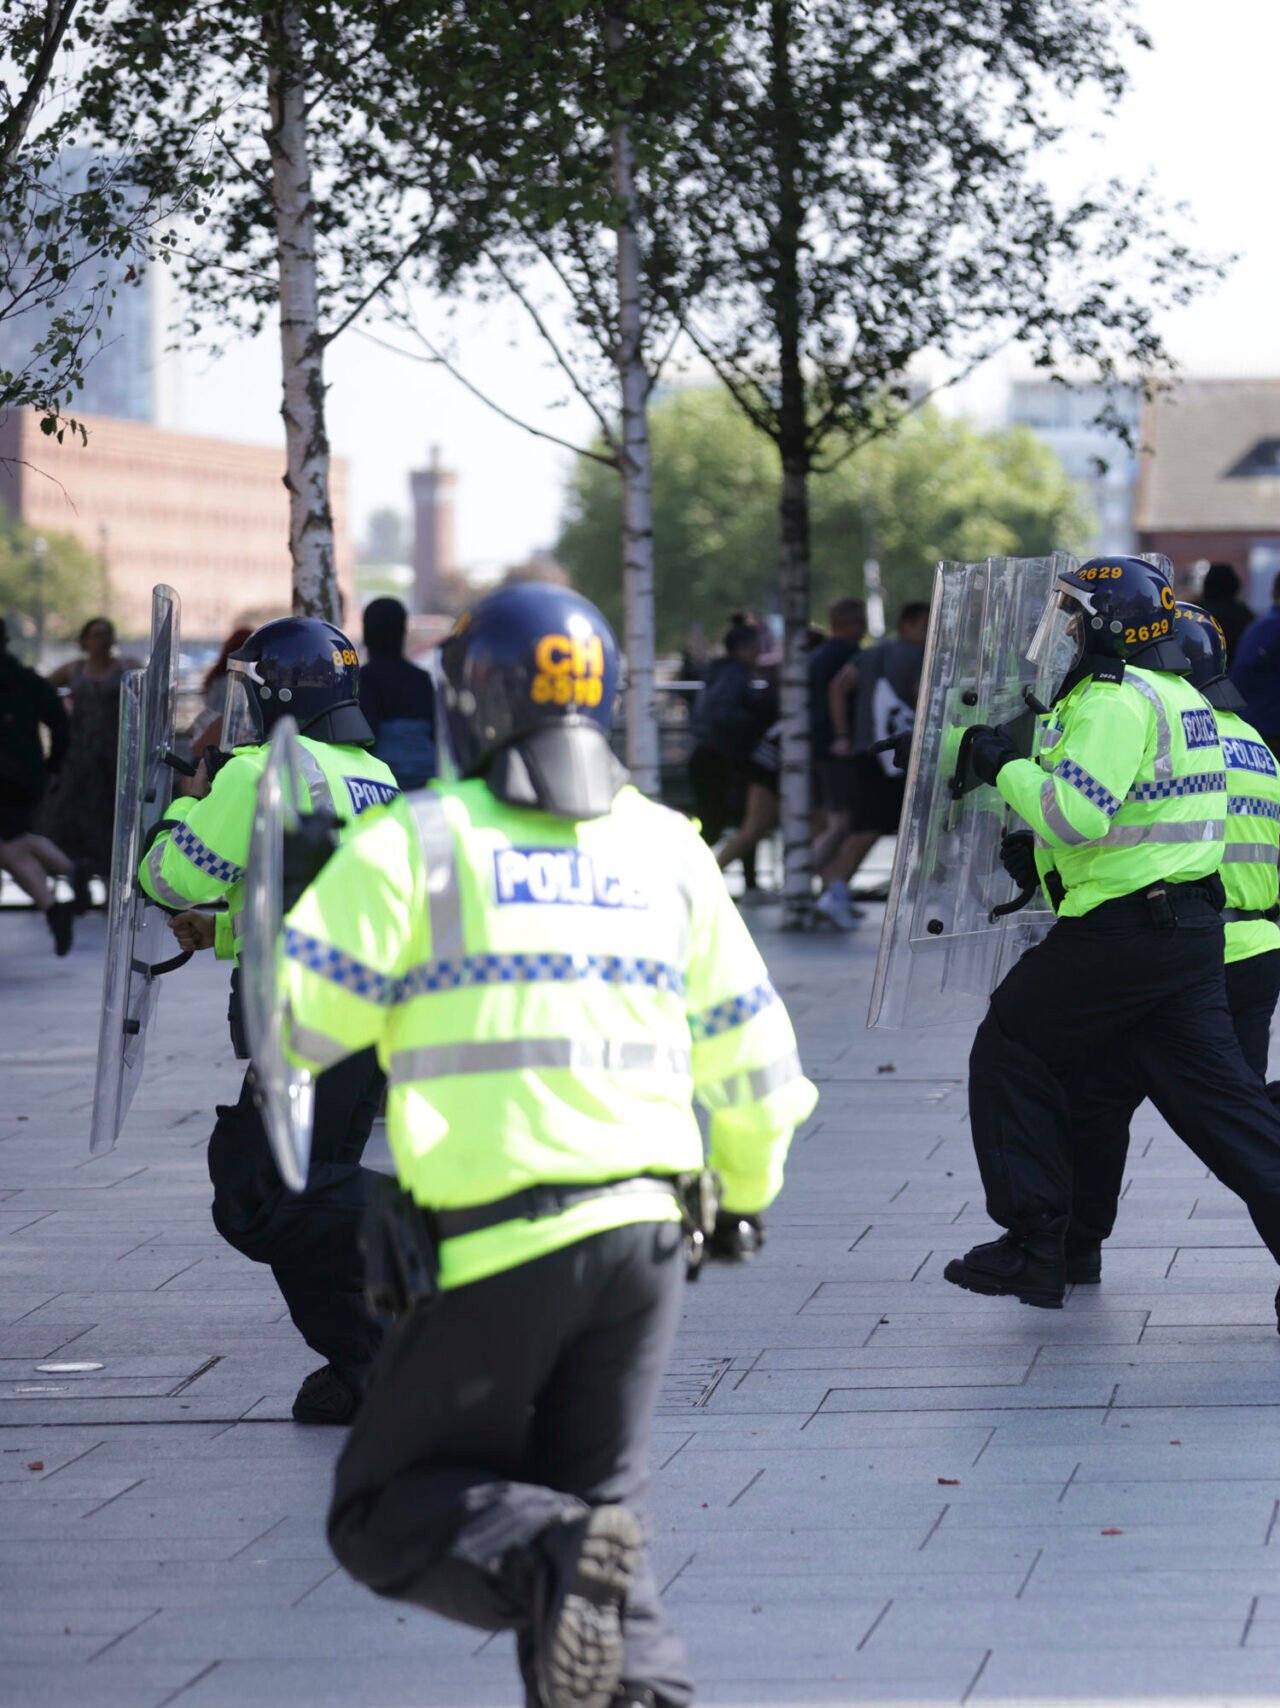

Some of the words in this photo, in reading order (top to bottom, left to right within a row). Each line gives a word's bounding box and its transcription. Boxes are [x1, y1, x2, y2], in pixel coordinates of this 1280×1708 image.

[1079, 567, 1122, 581] 2629
[1125, 619, 1169, 643] 2629
[534, 633, 605, 676] CH
[1222, 739, 1276, 771] POLICE
